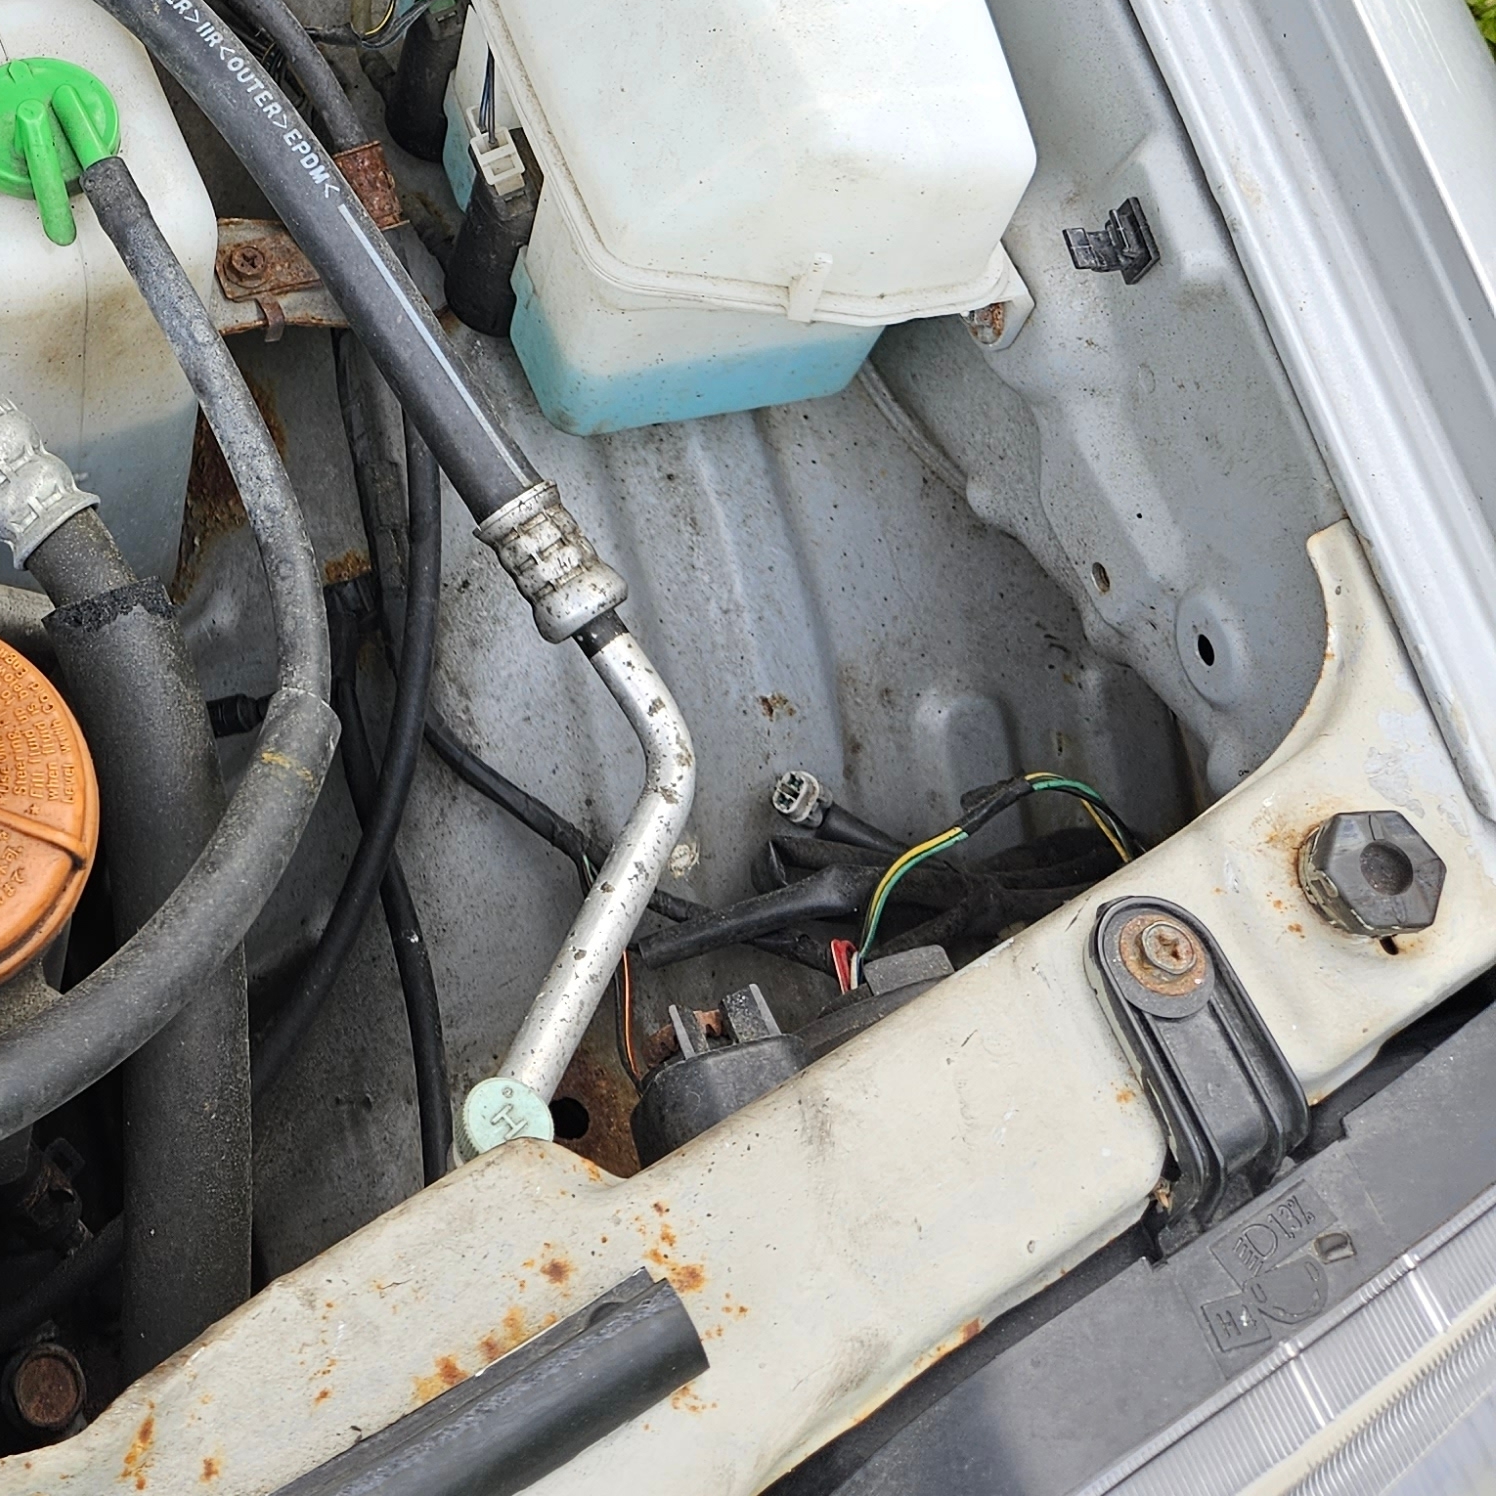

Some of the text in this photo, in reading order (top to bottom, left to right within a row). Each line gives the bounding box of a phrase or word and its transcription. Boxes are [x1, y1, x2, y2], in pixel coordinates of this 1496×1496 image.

[23, 729, 41, 764] fluid
[30, 771, 45, 798] Fill
[46, 761, 59, 801] when
